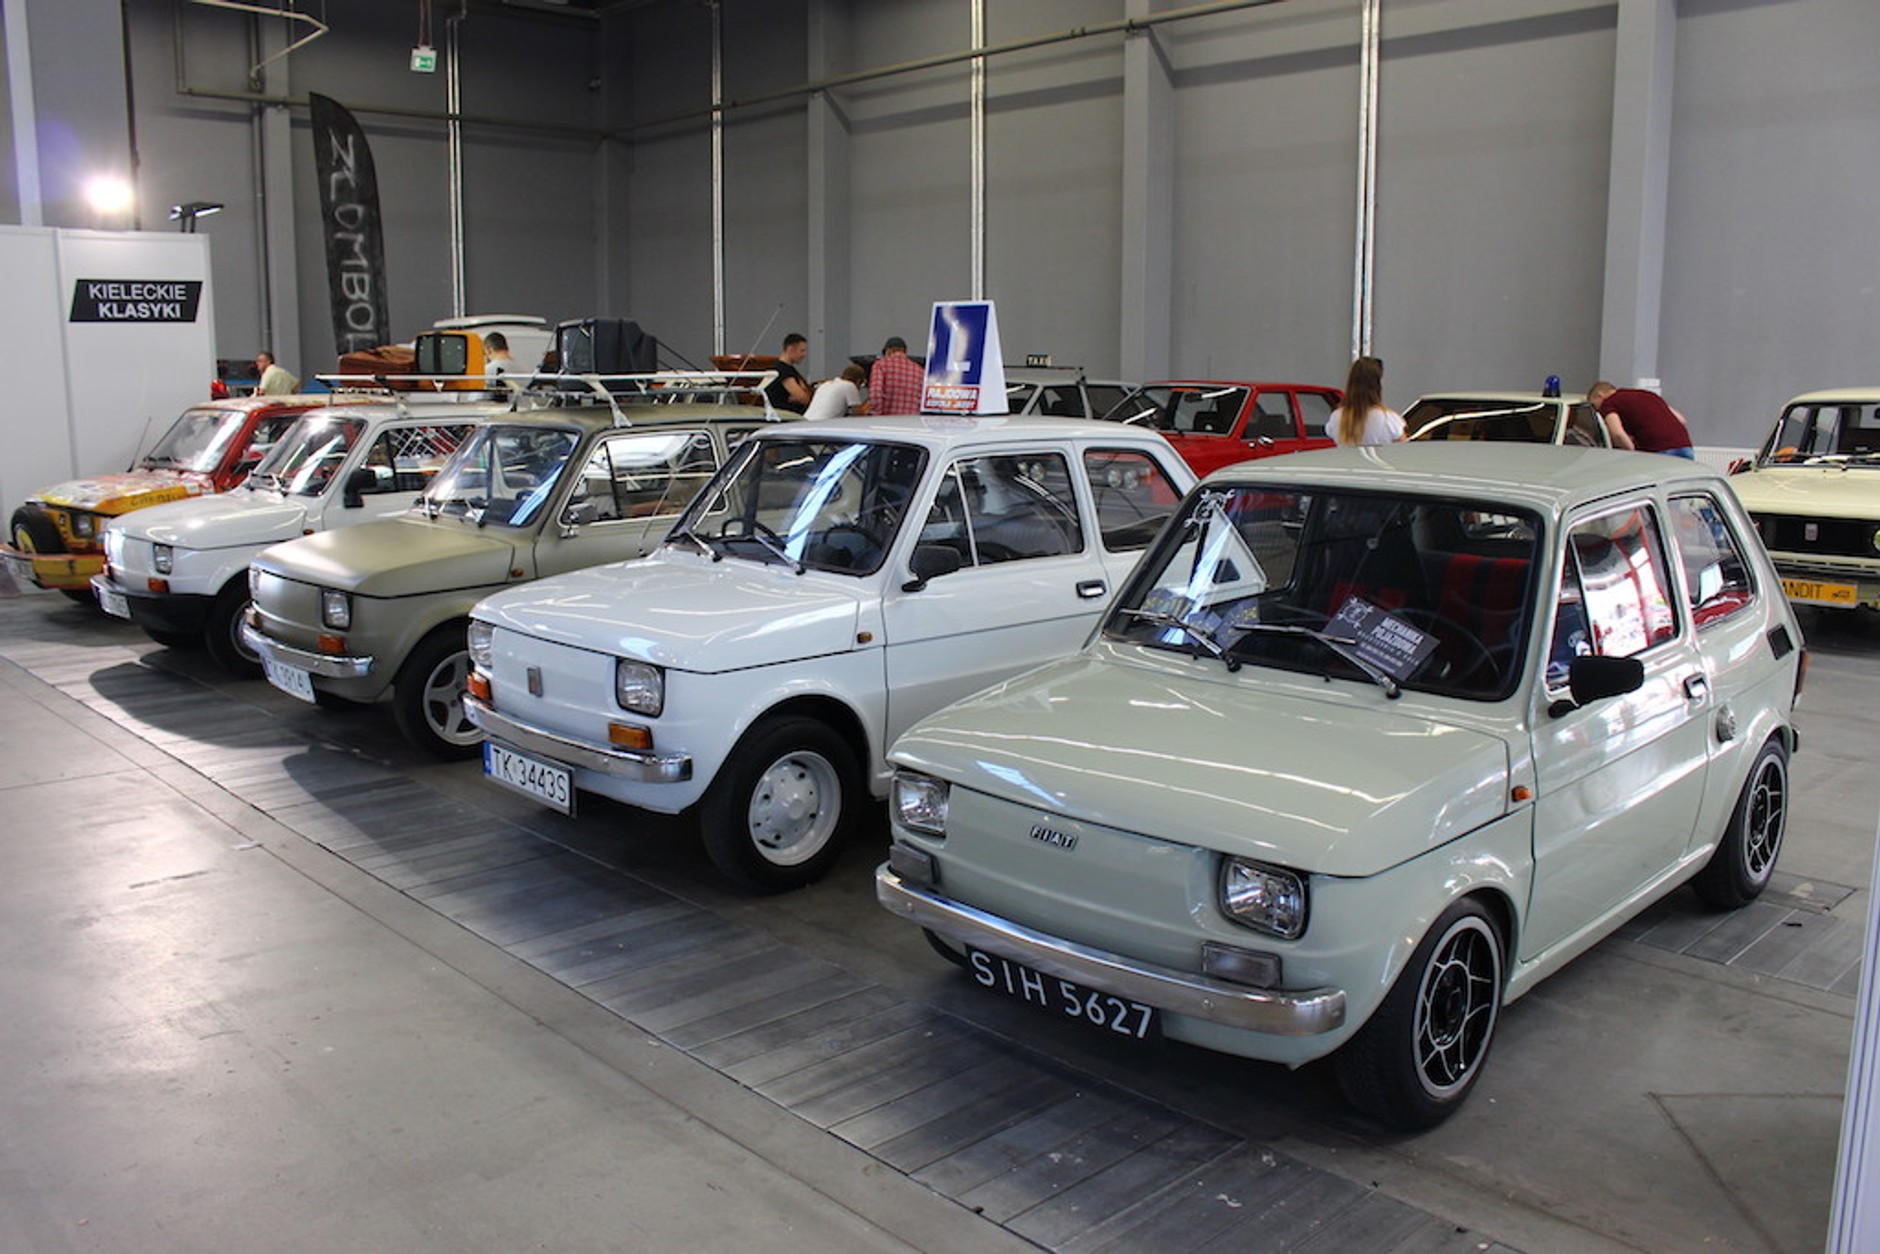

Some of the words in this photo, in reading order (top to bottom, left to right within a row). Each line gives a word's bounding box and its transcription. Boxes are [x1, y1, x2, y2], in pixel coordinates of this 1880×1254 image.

[88, 284, 187, 300] KIELECKIE
[98, 302, 181, 319] KLASYKI
[1027, 355, 1048, 366] TAXI
[493, 747, 513, 781] TK
[518, 758, 567, 802] 3443S
[1032, 826, 1074, 848] FIAT
[970, 951, 1047, 1006] SIH
[1060, 980, 1153, 1039] 5627
